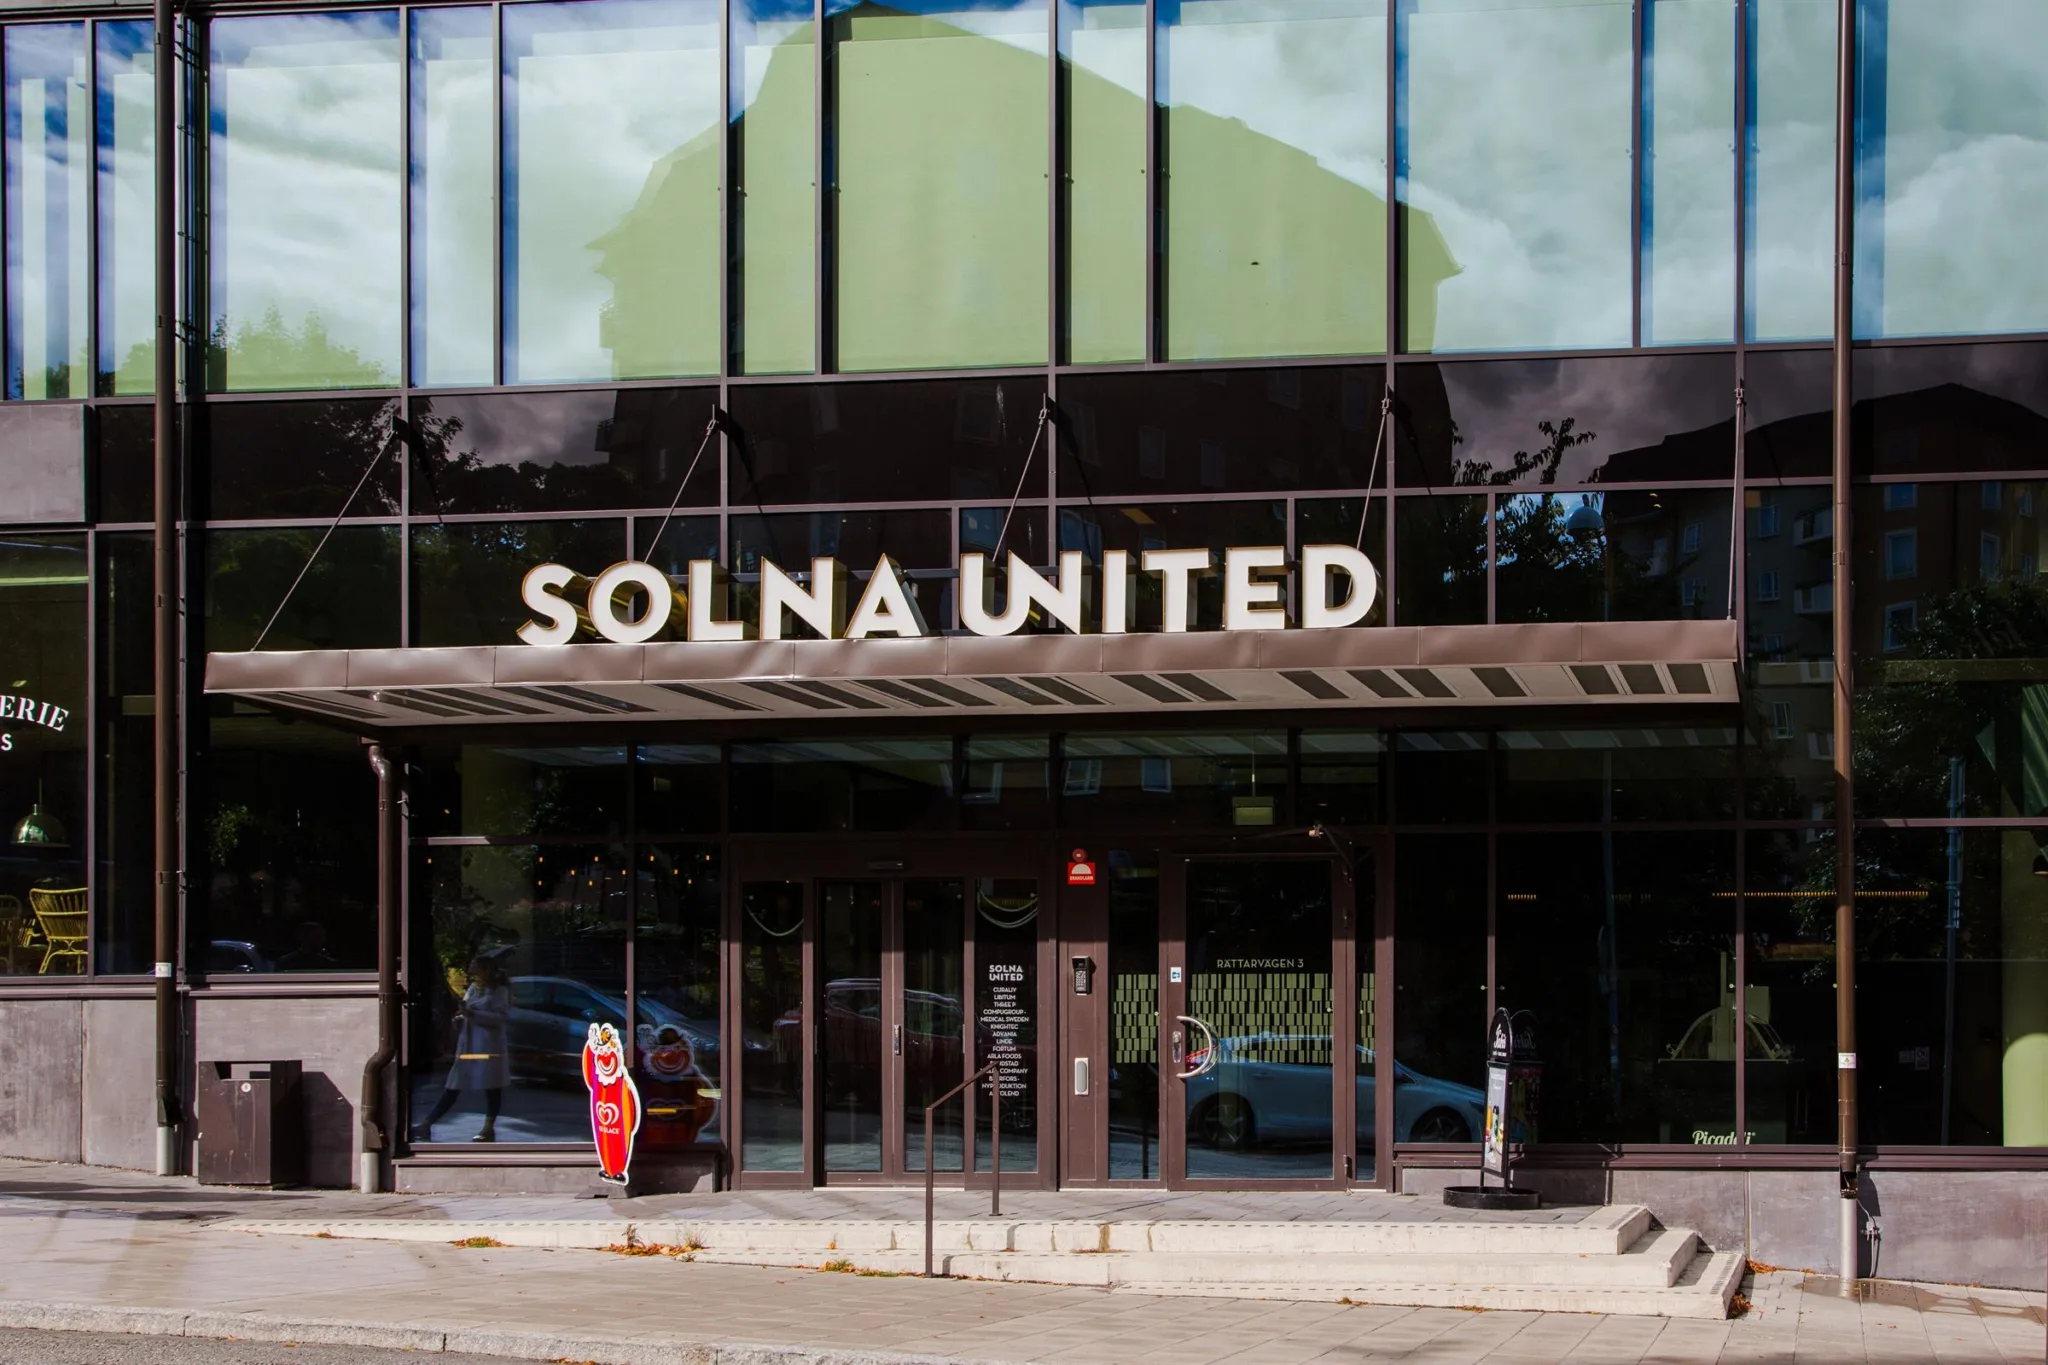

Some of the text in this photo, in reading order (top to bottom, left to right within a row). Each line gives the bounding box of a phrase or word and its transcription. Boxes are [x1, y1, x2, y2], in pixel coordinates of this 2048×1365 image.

[515, 543, 1379, 646] SOLNA UNITED
[989, 964, 1023, 973] SOLNA
[1217, 958, 1304, 969] RÄTTARVÄGEN 3
[989, 973, 1023, 981] UNITED
